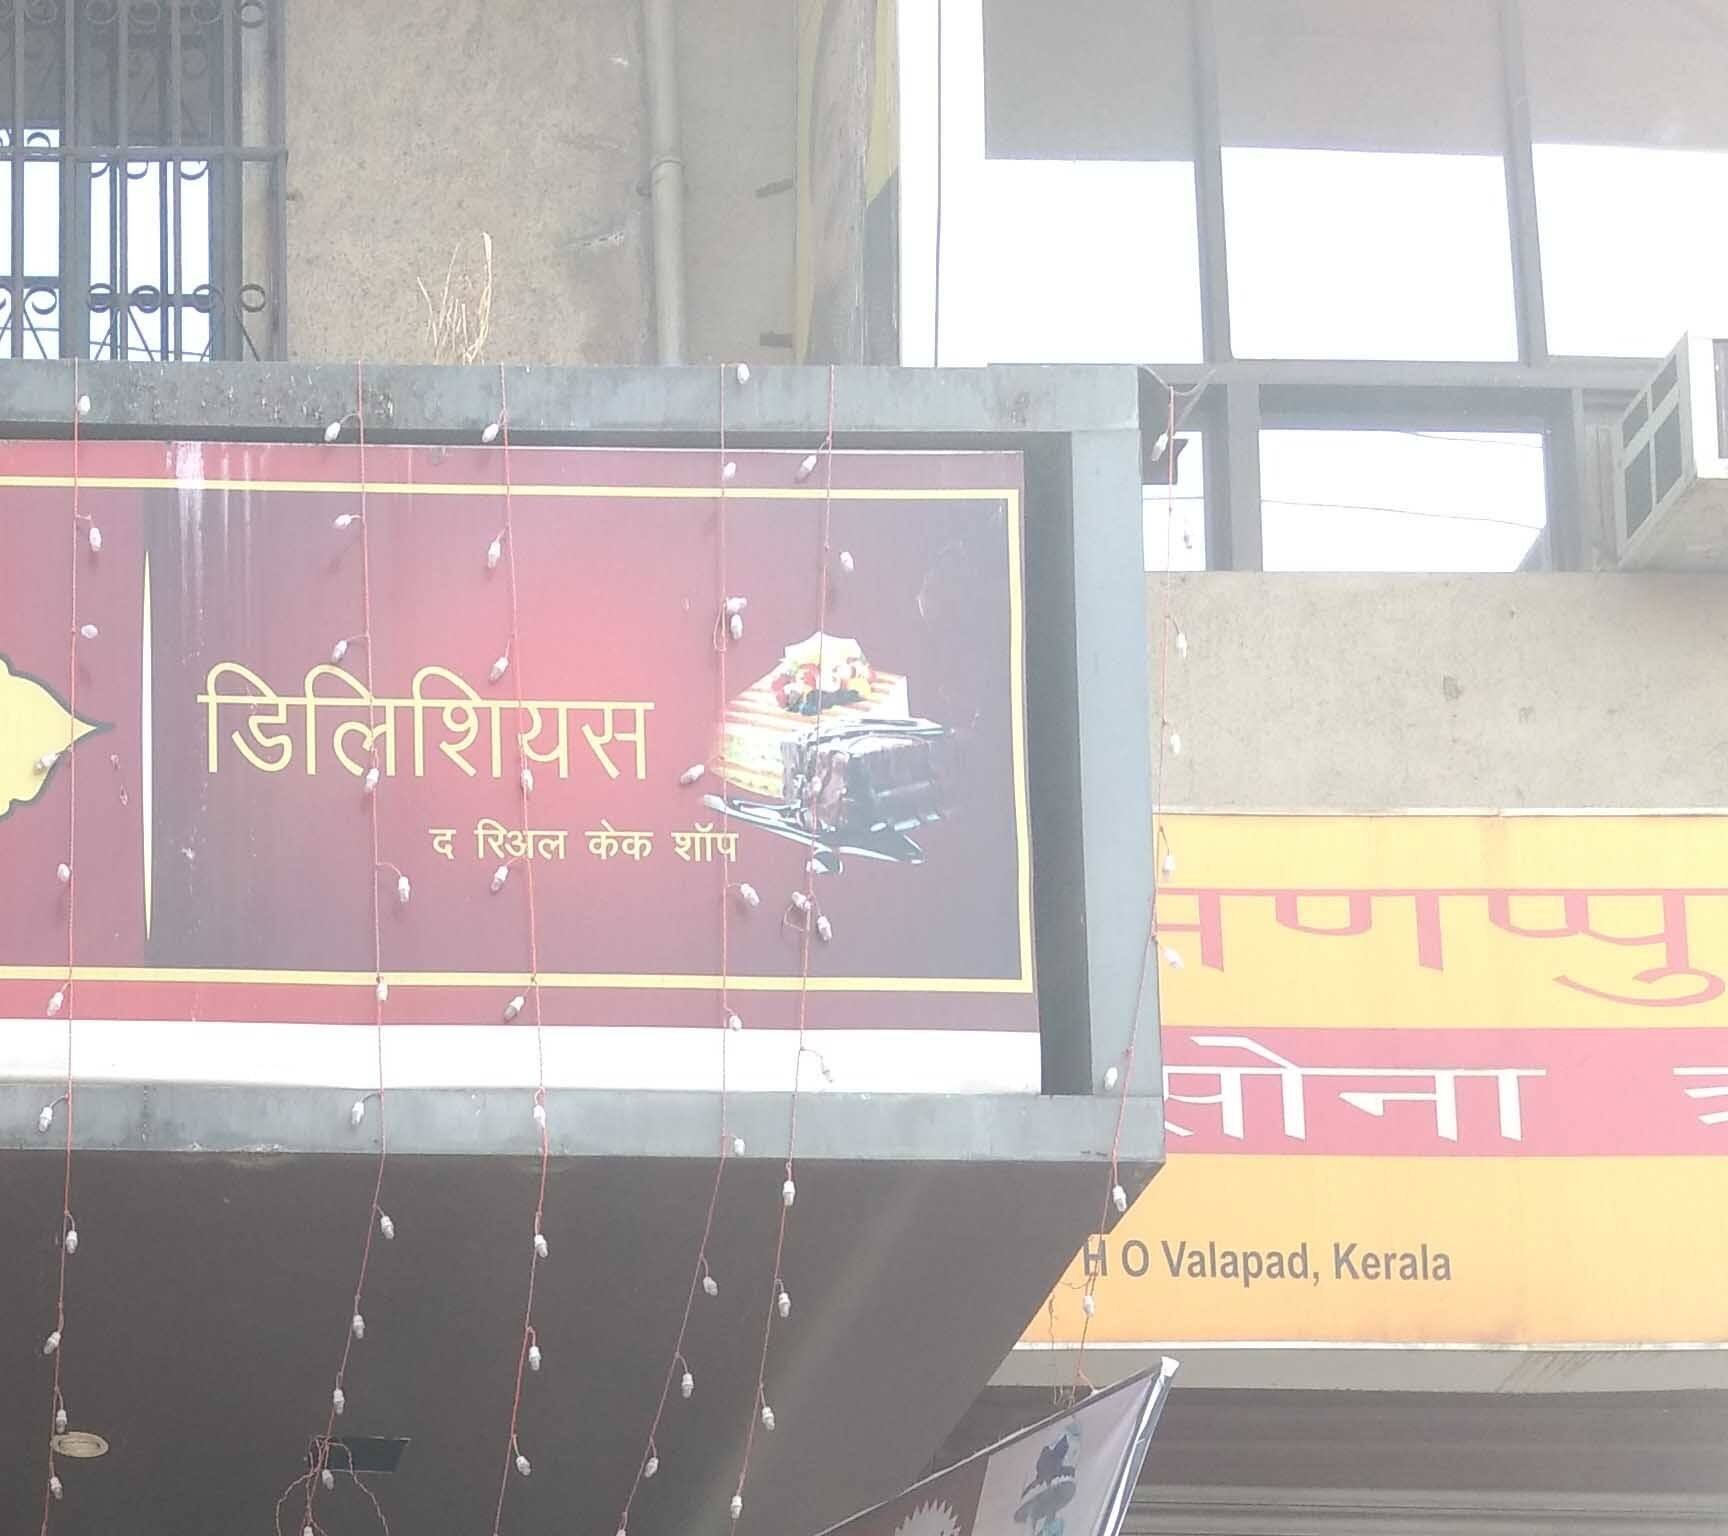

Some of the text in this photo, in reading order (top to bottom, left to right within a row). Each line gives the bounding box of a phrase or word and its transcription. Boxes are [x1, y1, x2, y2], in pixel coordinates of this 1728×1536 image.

[197, 661, 655, 781] डिलिशियस
[429, 819, 740, 864] द रिअल केक शॉप
[1121, 1239, 1151, 1279] O
[1162, 1239, 1322, 1288] Valapad,
[1333, 1242, 1453, 1282] Kerala
